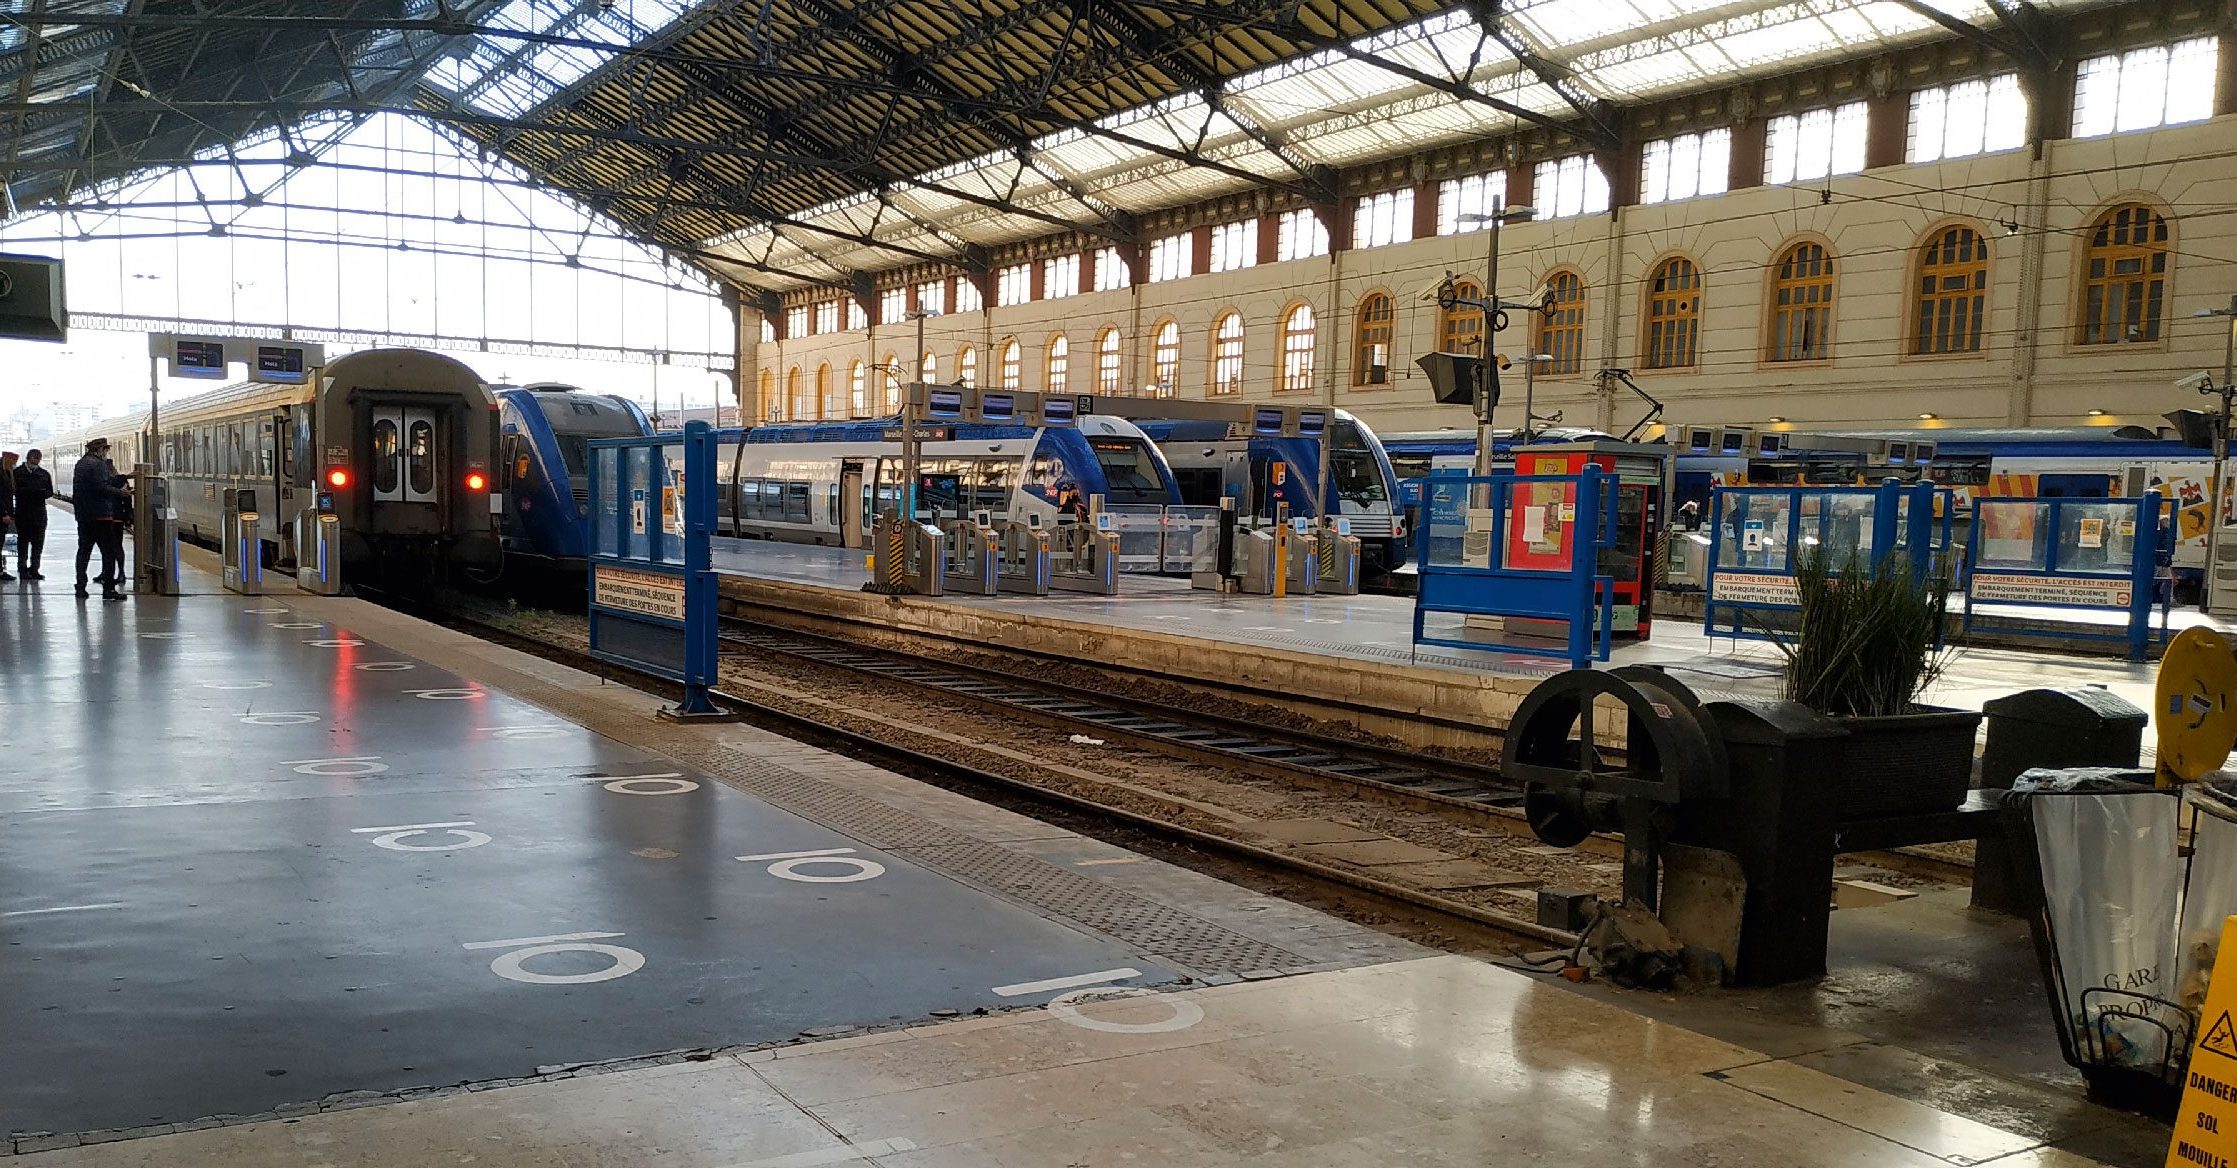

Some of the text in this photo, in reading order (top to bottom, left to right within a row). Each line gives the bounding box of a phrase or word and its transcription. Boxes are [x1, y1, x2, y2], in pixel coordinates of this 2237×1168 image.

[1978, 584, 2034, 593] EMBARQUEMENT
[2097, 580, 2131, 588] INTERDIT
[1719, 585, 1775, 594] EMBARQUEMENT
[1729, 593, 1768, 602] FERMETURE
[2043, 595, 2070, 603] PORTES
[2190, 1071, 2237, 1104] DANGER
[2197, 1111, 2219, 1134] SOL
[2177, 1140, 2229, 1168] MOUILLE
